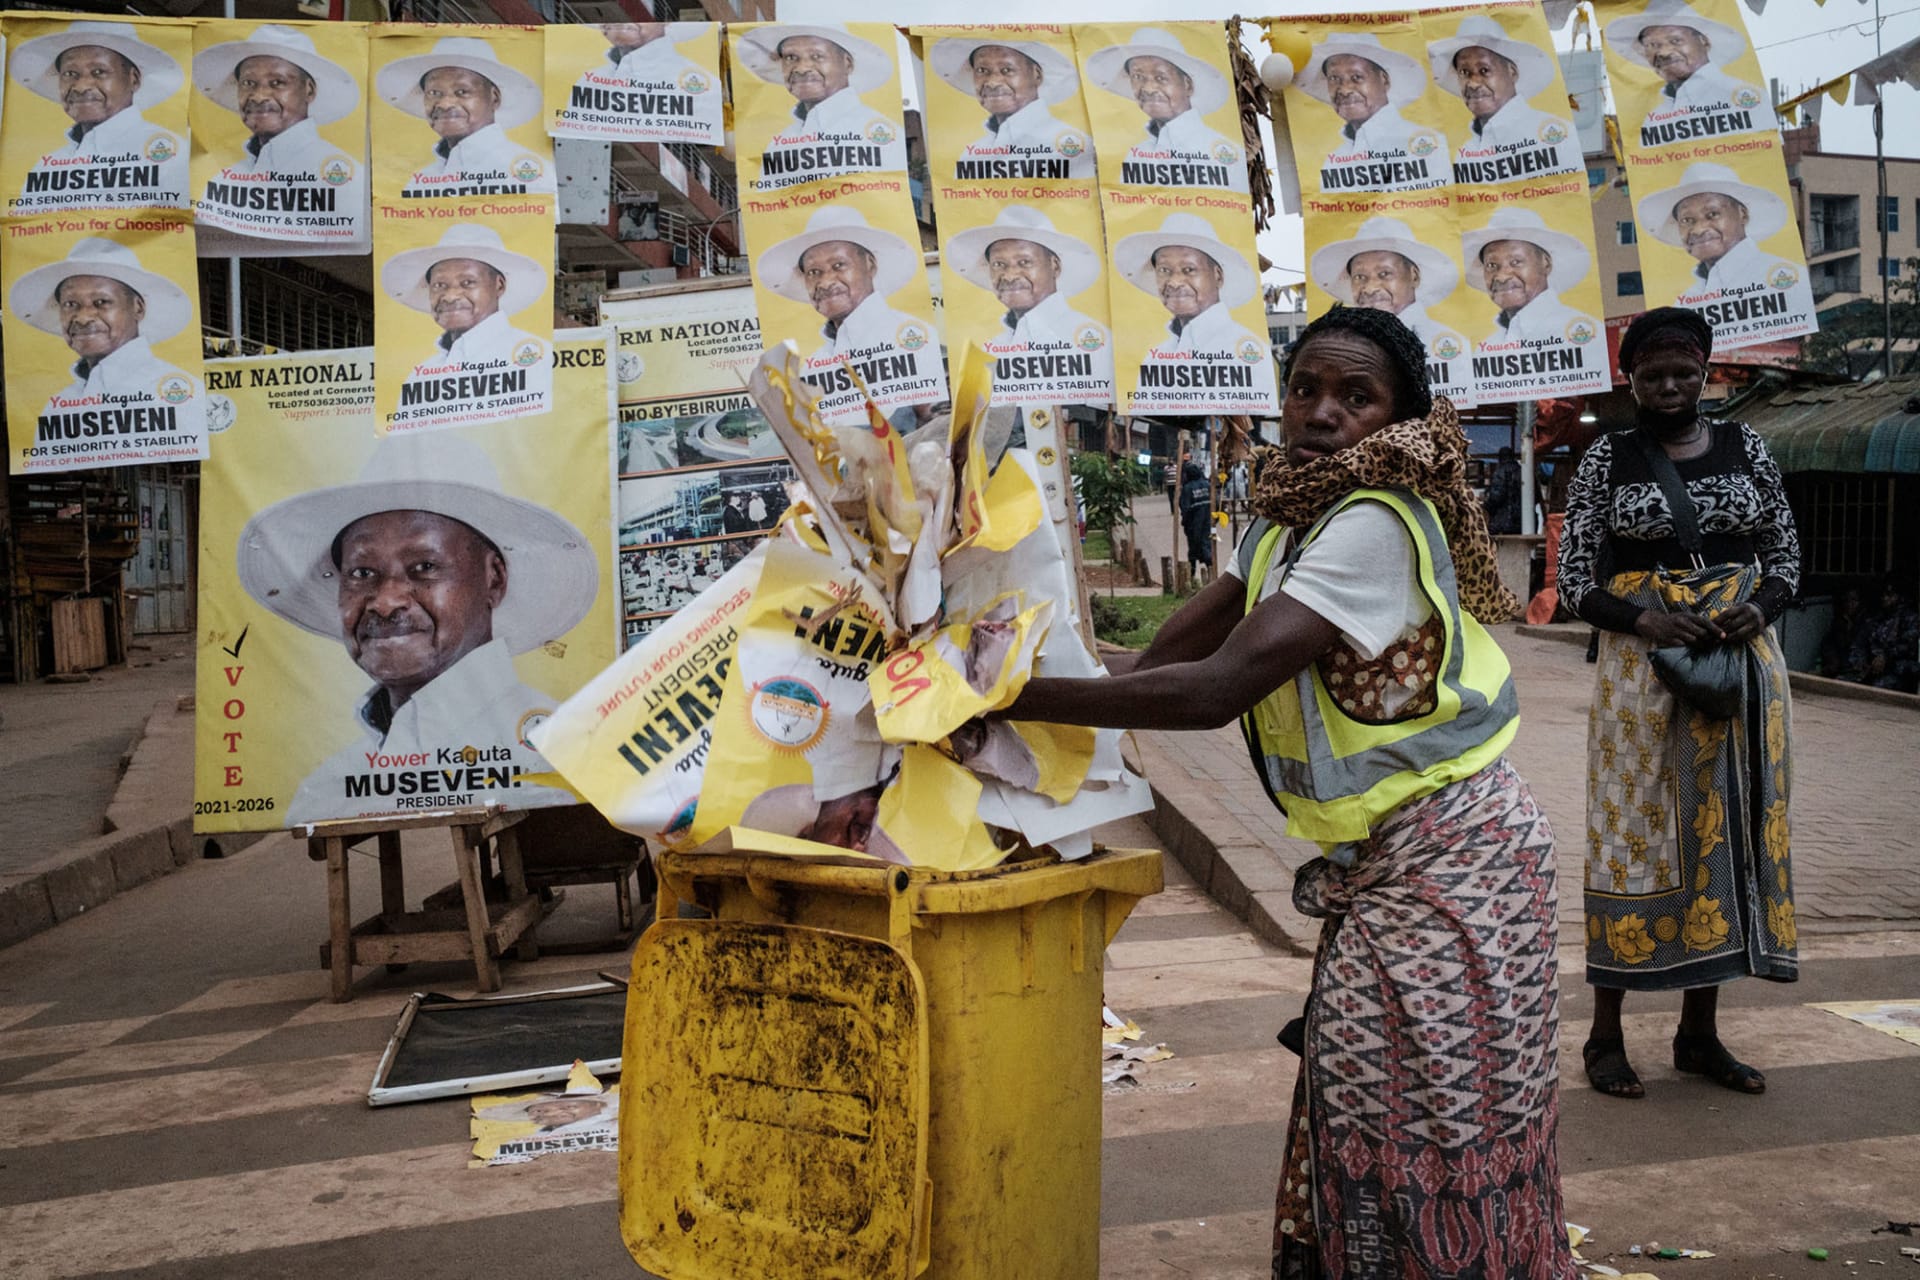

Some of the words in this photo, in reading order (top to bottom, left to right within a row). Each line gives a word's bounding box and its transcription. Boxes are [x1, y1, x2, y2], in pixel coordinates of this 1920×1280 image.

[572, 85, 694, 116] MUSEVENI
[556, 109, 578, 120] FOR
[582, 113, 642, 126] SENIORITY
[645, 118, 652, 126] &
[657, 119, 712, 130] STABILITY
[1641, 111, 1752, 146] MUSEVENI
[762, 146, 882, 175] MUSEVENI
[1630, 155, 1664, 165] Thank
[1666, 152, 1690, 163] You
[1694, 147, 1711, 157] for
[1714, 139, 1772, 154] Choosing
[956, 159, 1070, 179] MUSEVENI
[1122, 162, 1229, 186] MUSEVENI
[1320, 159, 1428, 189] MUSEVENI
[1453, 147, 1559, 184] MUSEVENI
[26, 165, 159, 192] MUSEVENI
[750, 180, 771, 189] FOR
[8, 199, 32, 207] FOR
[37, 193, 102, 205] SENIORITY
[105, 193, 114, 201] &
[118, 192, 180, 202] STABILITY
[207, 181, 335, 212] MUSEVENI
[748, 200, 789, 213] Thank
[790, 193, 817, 207] You
[819, 188, 838, 200] for
[840, 180, 900, 195] Choosing
[942, 188, 981, 199] Thank
[984, 188, 1008, 199] You
[1011, 188, 1028, 198] for
[1032, 187, 1090, 198] Choosing
[1110, 192, 1145, 204] Thank
[1148, 195, 1171, 206] You
[1175, 196, 1192, 206] for
[1195, 196, 1248, 213] Choosing
[1478, 192, 1499, 203] You
[1502, 189, 1520, 200] for
[1522, 180, 1581, 200] Choosing
[381, 206, 424, 219] Thank
[428, 207, 454, 217] You
[458, 205, 477, 216] for
[481, 203, 545, 215] Choosing
[1310, 201, 1344, 213] Thank
[1347, 201, 1368, 212] You
[1371, 201, 1388, 212] for
[1391, 197, 1449, 210] Choosing
[9, 223, 53, 238] Thank
[56, 220, 84, 232] You
[89, 219, 109, 231] for
[115, 218, 185, 232] Choosing
[217, 208, 281, 225] SENIORITY
[285, 217, 292, 225] &
[296, 217, 354, 226] STABILITY
[1694, 292, 1788, 326] SEVENI
[1753, 314, 1807, 330] STABILITY
[687, 337, 728, 347] Located
[732, 333, 742, 342] at
[996, 354, 1092, 380] USEVENI
[1473, 347, 1583, 378] MUSEVENI
[204, 370, 242, 390] RM
[251, 364, 361, 387] NATIONAL
[401, 369, 526, 406] MUSEVENI
[871, 389, 879, 397] &
[882, 378, 937, 394] STABILITY
[993, 382, 1043, 392] ENIORITY
[1057, 380, 1110, 390] STABILITY
[1140, 365, 1252, 387] MUSEVENI
[1481, 378, 1536, 390] SENIORITY
[1548, 371, 1601, 384] STABILITY
[268, 390, 309, 398] Located
[1127, 392, 1148, 400] FOR
[1151, 392, 1206, 400] SENIORITY
[1209, 392, 1216, 400] &
[1220, 392, 1270, 400] STABILITY
[386, 411, 408, 422] FOR
[412, 402, 473, 418] SENIORITY
[477, 401, 484, 410] &
[488, 392, 544, 408] STABILITY
[38, 407, 177, 441] MUSEVENI
[22, 447, 48, 457] FOR
[52, 441, 118, 455] SENIORITY
[135, 435, 199, 447] STABILITY
[22, 455, 56, 468] OFFICE
[74, 455, 95, 463] NRM
[98, 451, 144, 461] NATIONAL
[147, 448, 199, 457] CHAIRMAN
[687, 587, 751, 644] SECURING
[652, 641, 688, 672] YOUR
[643, 625, 738, 713] PRESIDENT
[816, 657, 870, 682] guta
[597, 671, 652, 719] FUTURE
[223, 666, 245, 788] VOTE
[365, 752, 430, 768] Yower
[437, 745, 512, 767] Kaguta
[345, 766, 521, 798] MUSEVENI
[194, 797, 274, 815] 2021-2026
[397, 794, 474, 809] PRESIDENT
